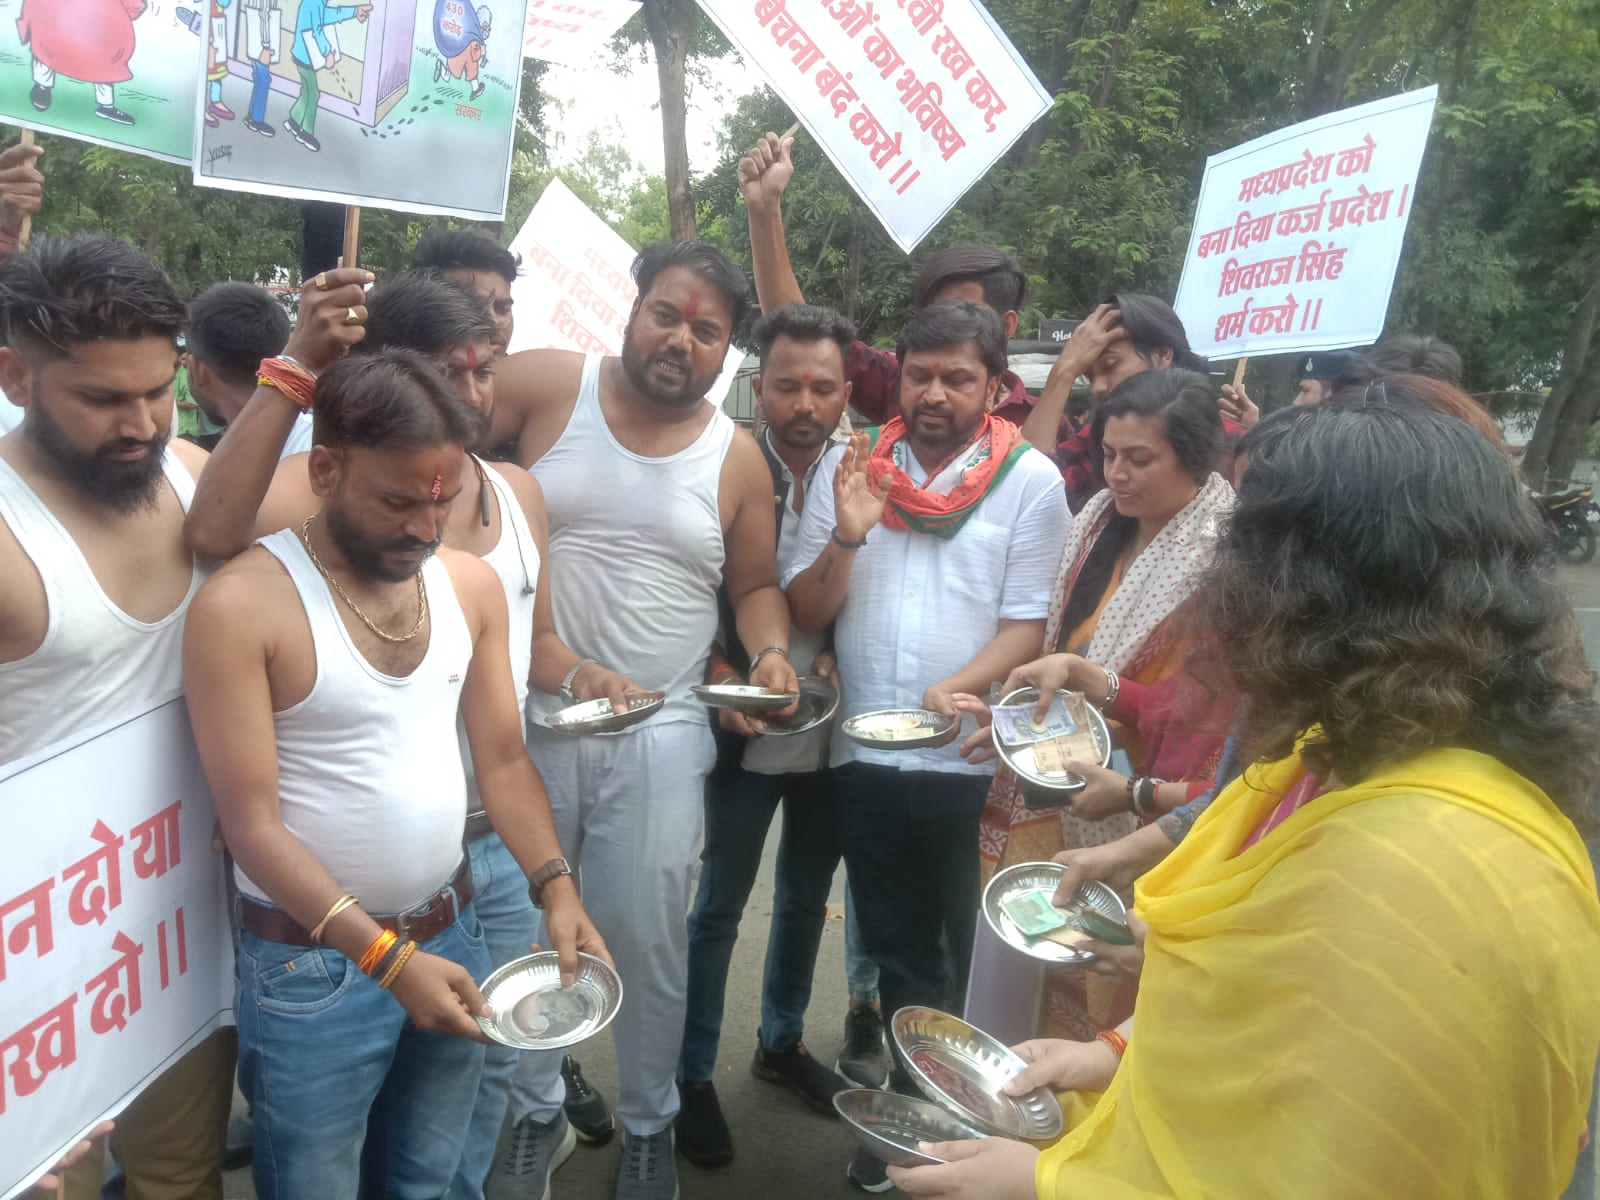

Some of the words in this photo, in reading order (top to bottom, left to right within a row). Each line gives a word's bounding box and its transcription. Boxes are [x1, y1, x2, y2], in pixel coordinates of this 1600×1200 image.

[446, 2, 464, 16] 430
[897, 0, 944, 37] वी
[931, 24, 975, 80] रख
[815, 62, 859, 119] बंद
[820, 0, 881, 39] ओं
[863, 27, 904, 80] का
[896, 69, 966, 161] भविष्य
[1238, 149, 1335, 203] मध्यप्रदेश
[1336, 133, 1377, 177] को
[1197, 227, 1232, 258] बना
[1231, 211, 1276, 250] दिया
[1276, 190, 1332, 236] कर्ज
[1328, 184, 1394, 232] प्रदेश
[1218, 257, 1296, 298] शिवराज
[1297, 240, 1348, 281] सिंह
[1214, 297, 1254, 342] शर्म
[0, 878, 55, 982] न
[62, 818, 124, 927] दो
[130, 799, 182, 880] या
[0, 991, 78, 1115] ख
[85, 930, 144, 1034] दो
